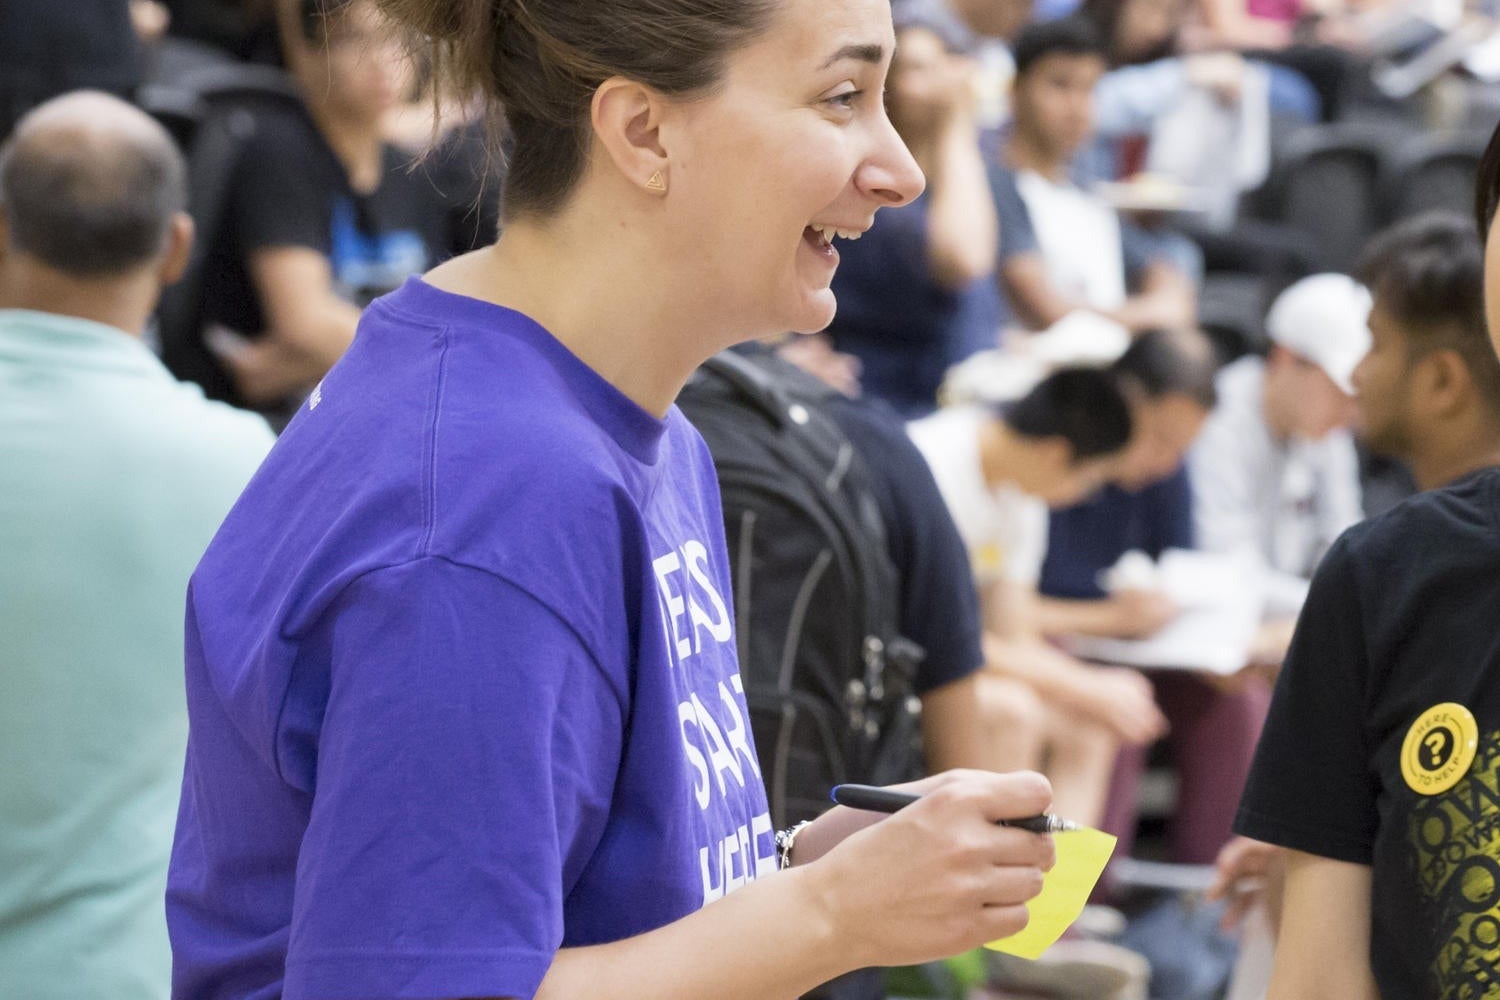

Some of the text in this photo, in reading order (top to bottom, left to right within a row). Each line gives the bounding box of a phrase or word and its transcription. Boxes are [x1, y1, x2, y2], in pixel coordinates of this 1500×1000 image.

[1416, 712, 1449, 735] HERE
[1418, 756, 1460, 787] TO HELP
